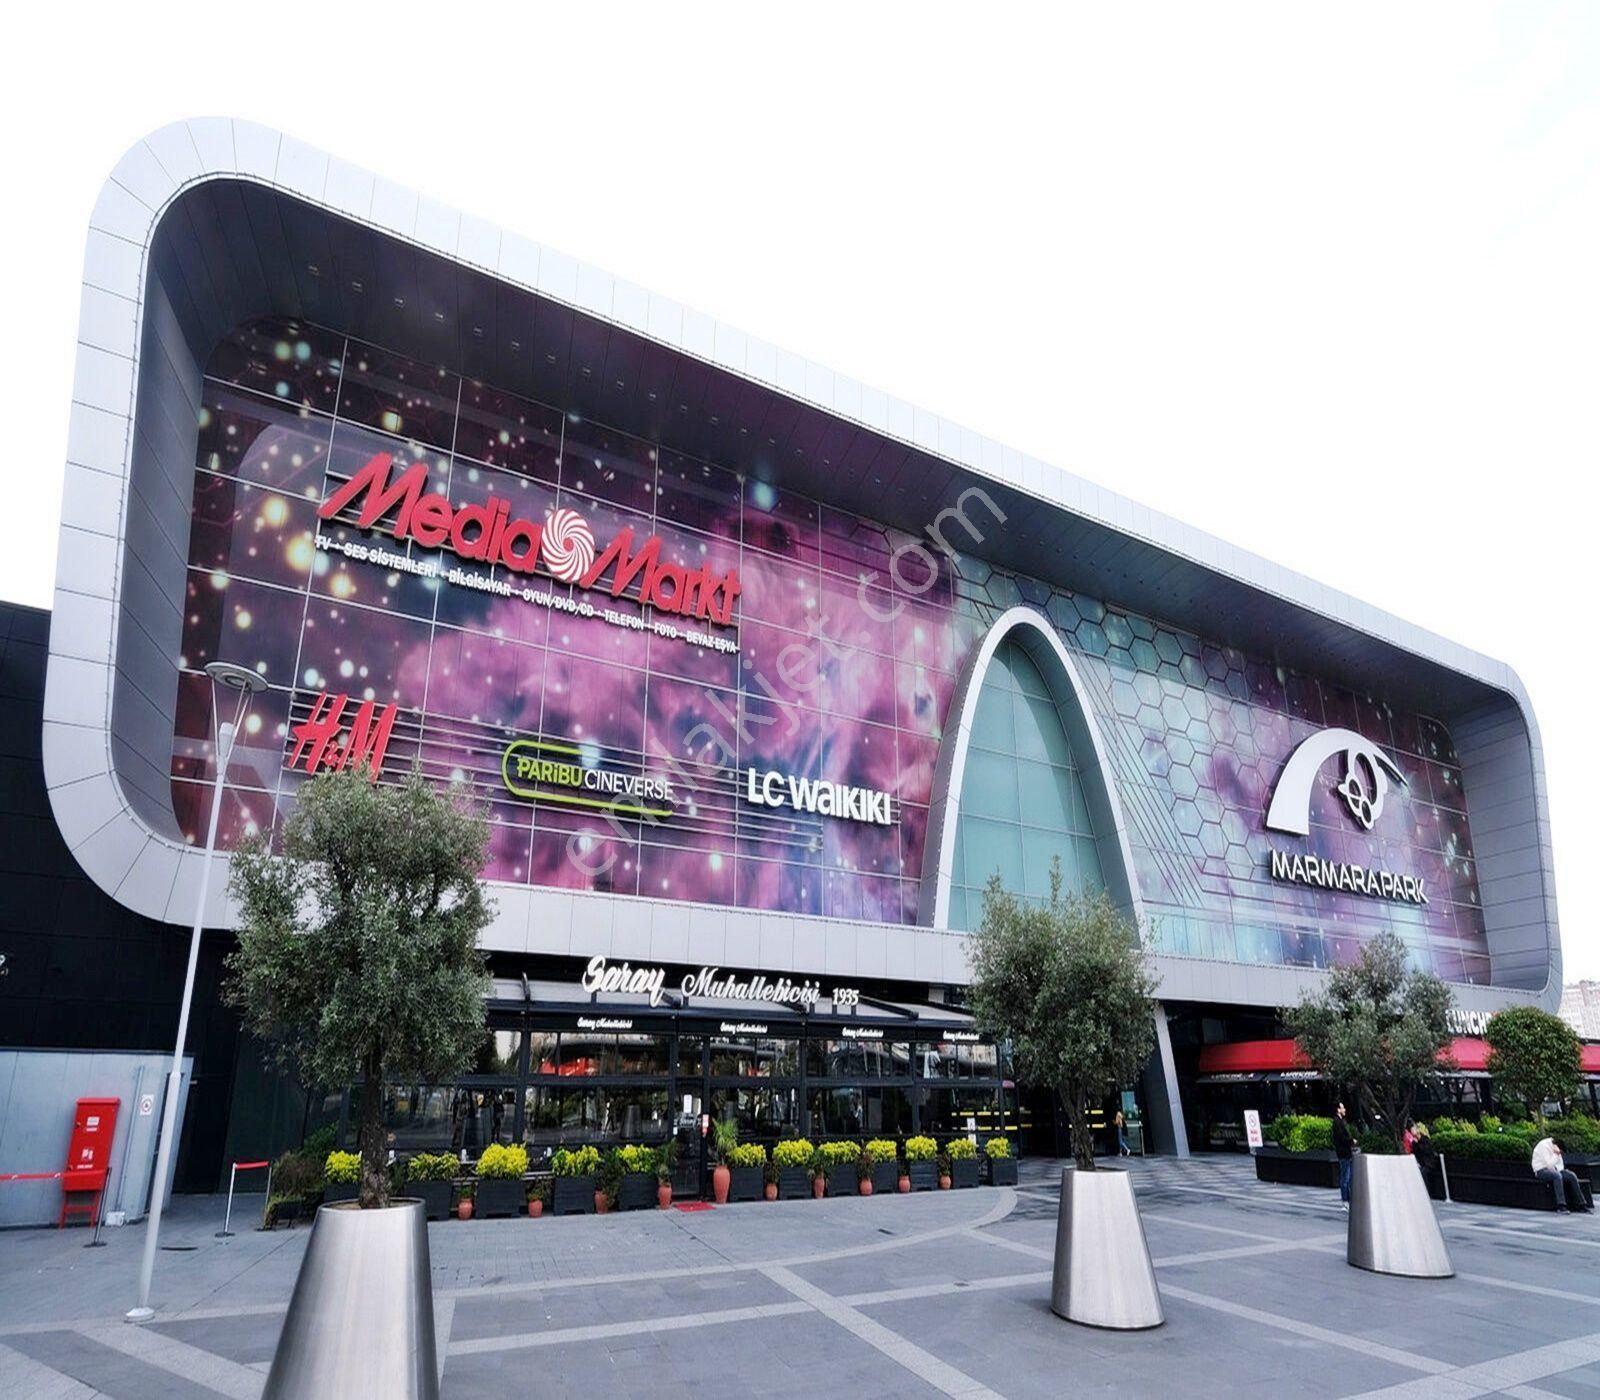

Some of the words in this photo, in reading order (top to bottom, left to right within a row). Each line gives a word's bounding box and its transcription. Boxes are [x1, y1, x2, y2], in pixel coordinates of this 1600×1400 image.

[317, 452, 543, 574] Media
[579, 528, 741, 625] Markt
[315, 535, 331, 551] TV
[343, 542, 369, 560] SES
[369, 547, 437, 578] SİSTEMLERİ
[449, 567, 511, 597] BİLGİSAYAR
[522, 588, 594, 617] OYUN/DVD/CD
[604, 609, 645, 630] TELEFON
[654, 622, 677, 638] FOTO
[686, 631, 715, 649] BEYAZ
[715, 639, 737, 654] EŞYA
[288, 691, 397, 784] H&M
[584, 769, 674, 801] CINEVERSE
[748, 768, 785, 807] LC
[1271, 849, 1429, 903] MARMARAPARK
[582, 955, 665, 1007] Saray
[681, 966, 820, 1005] Muhallebicisi
[832, 987, 859, 1006] 1935
